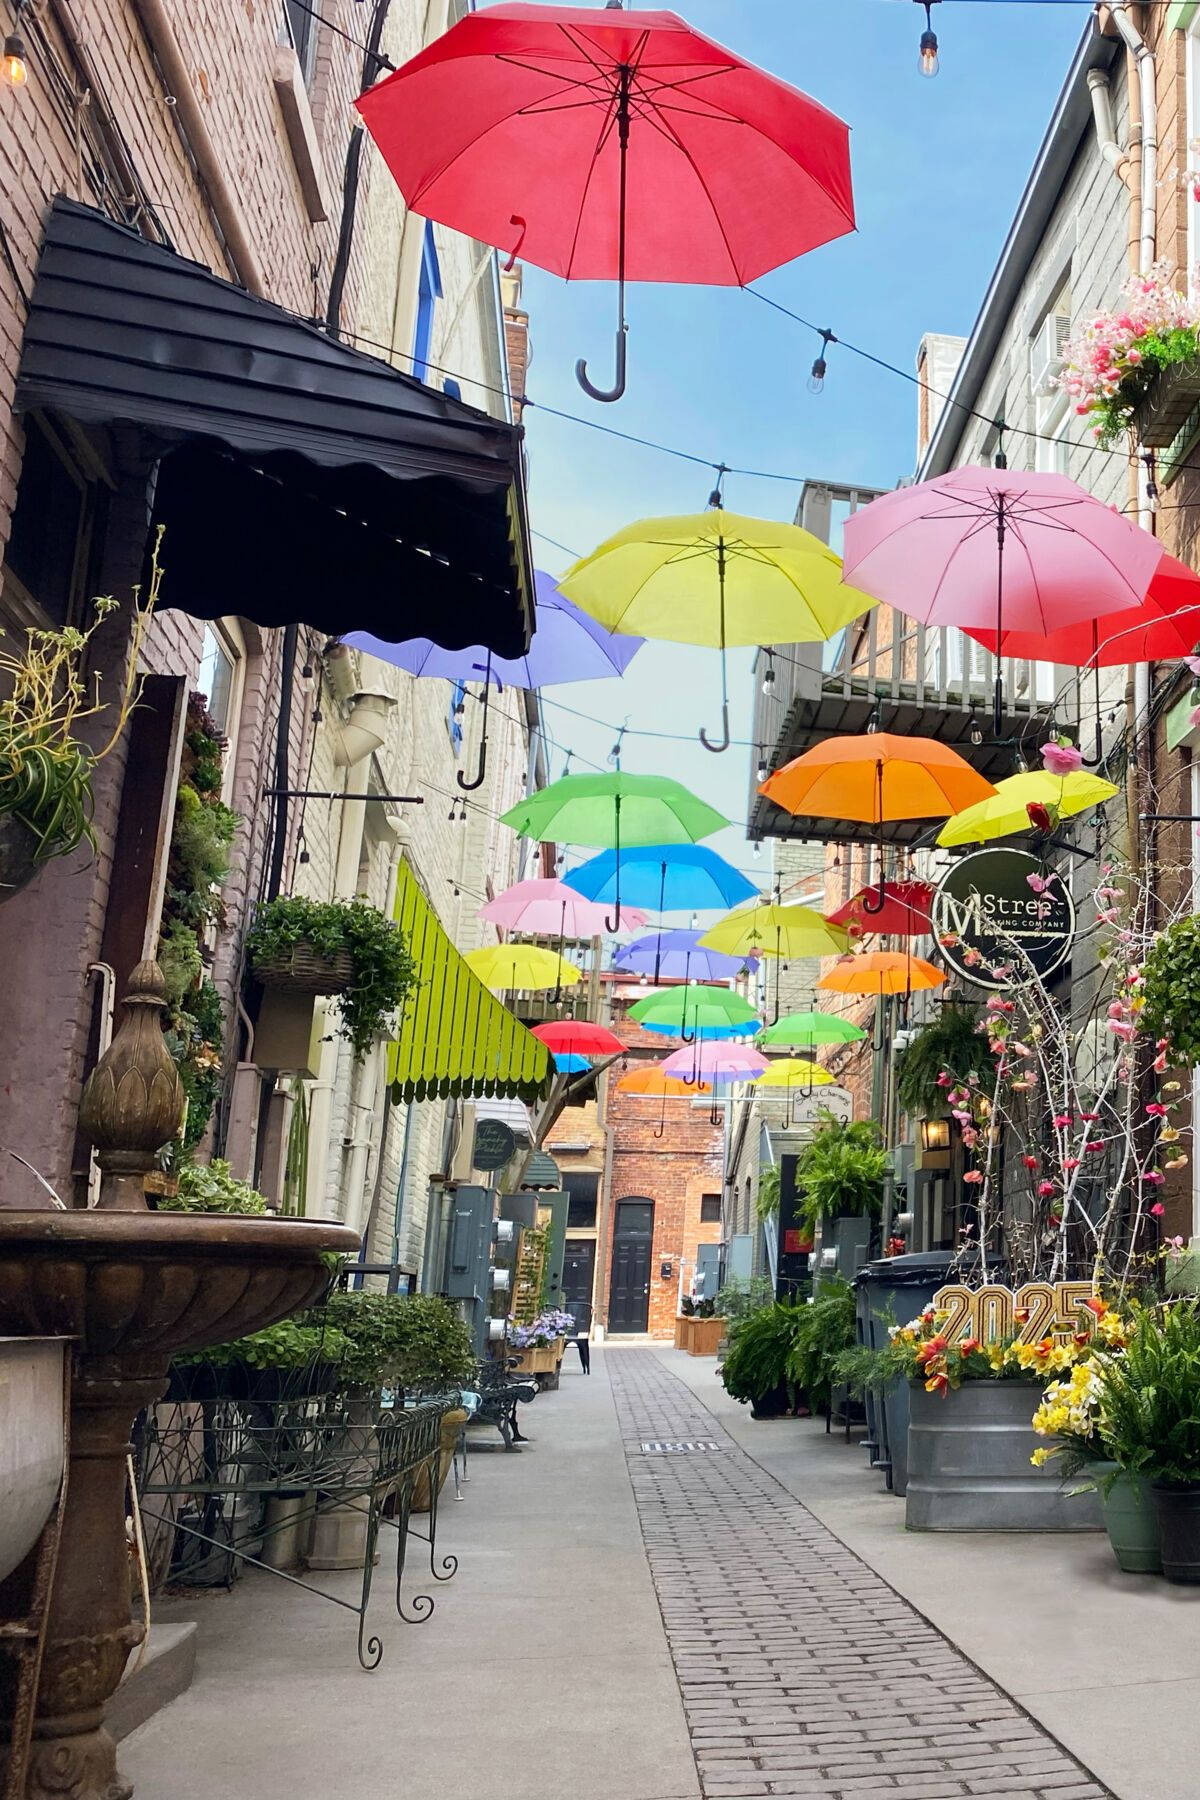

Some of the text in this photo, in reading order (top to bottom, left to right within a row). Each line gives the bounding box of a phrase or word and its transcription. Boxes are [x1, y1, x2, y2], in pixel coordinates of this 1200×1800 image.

[942, 892, 981, 937] M
[1022, 920, 1065, 928] COMPANY
[933, 1281, 1098, 1348] 2025
